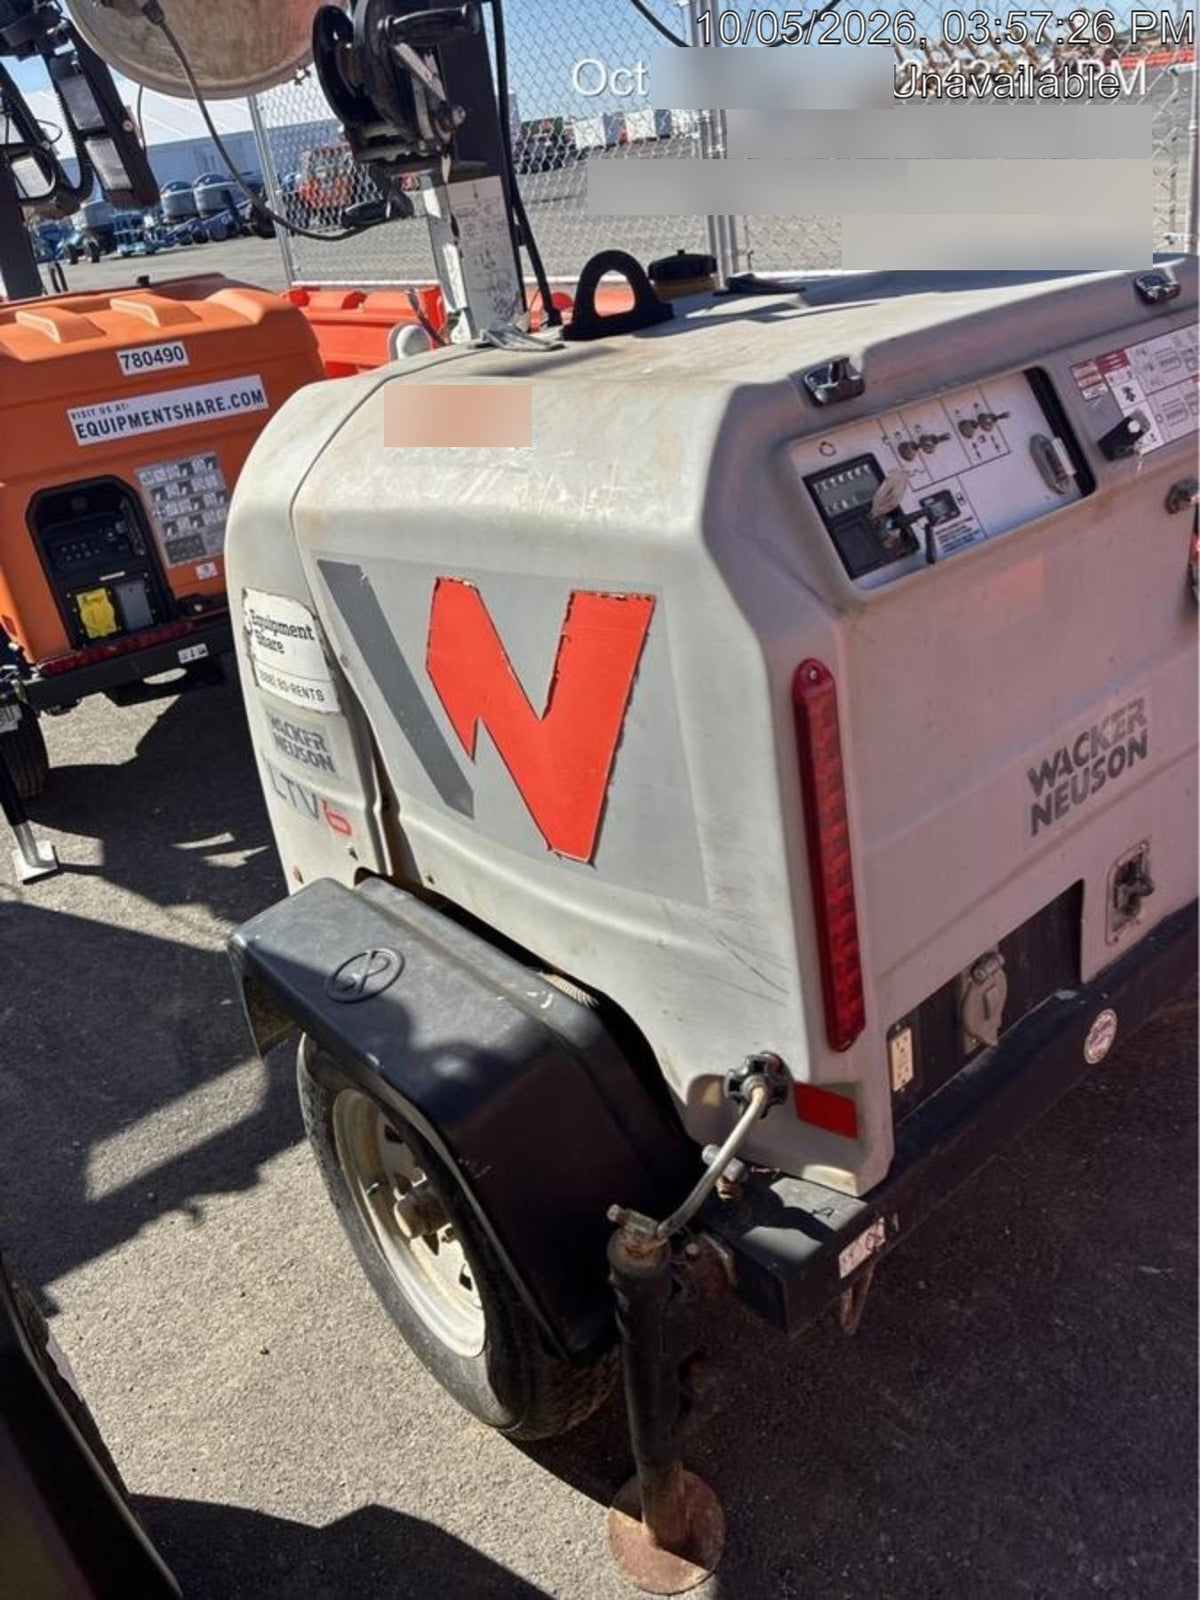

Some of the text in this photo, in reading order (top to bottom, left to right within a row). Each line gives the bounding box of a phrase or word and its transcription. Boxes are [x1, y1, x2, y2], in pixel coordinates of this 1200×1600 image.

[120, 345, 185, 371] 780490
[75, 389, 265, 439] EQUIPMENTSHARE.COM
[1026, 696, 1148, 798] WACKER
[1029, 727, 1149, 838] NEUSON
